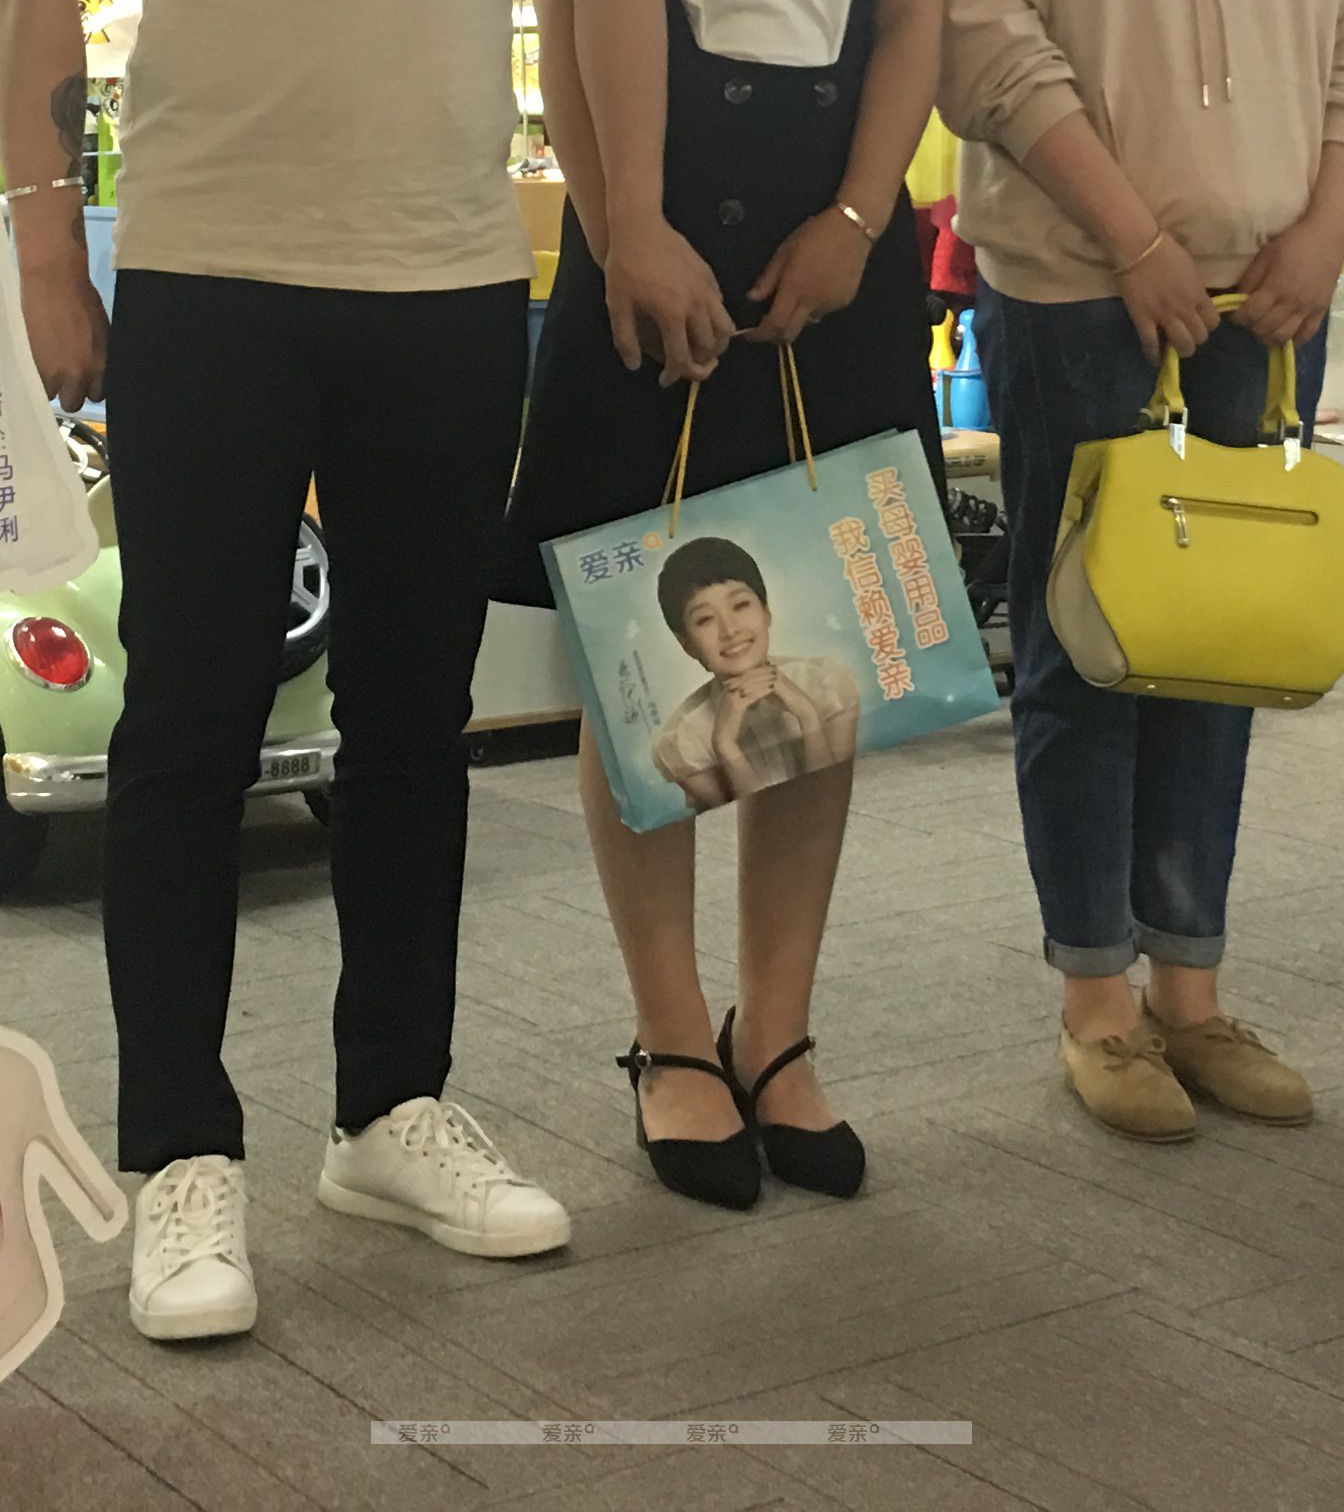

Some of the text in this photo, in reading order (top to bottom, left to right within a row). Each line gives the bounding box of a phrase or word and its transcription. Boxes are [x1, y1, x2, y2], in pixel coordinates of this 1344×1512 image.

[828, 515, 915, 702] 我信赖爱亲
[865, 467, 950, 650] 买母婴用品
